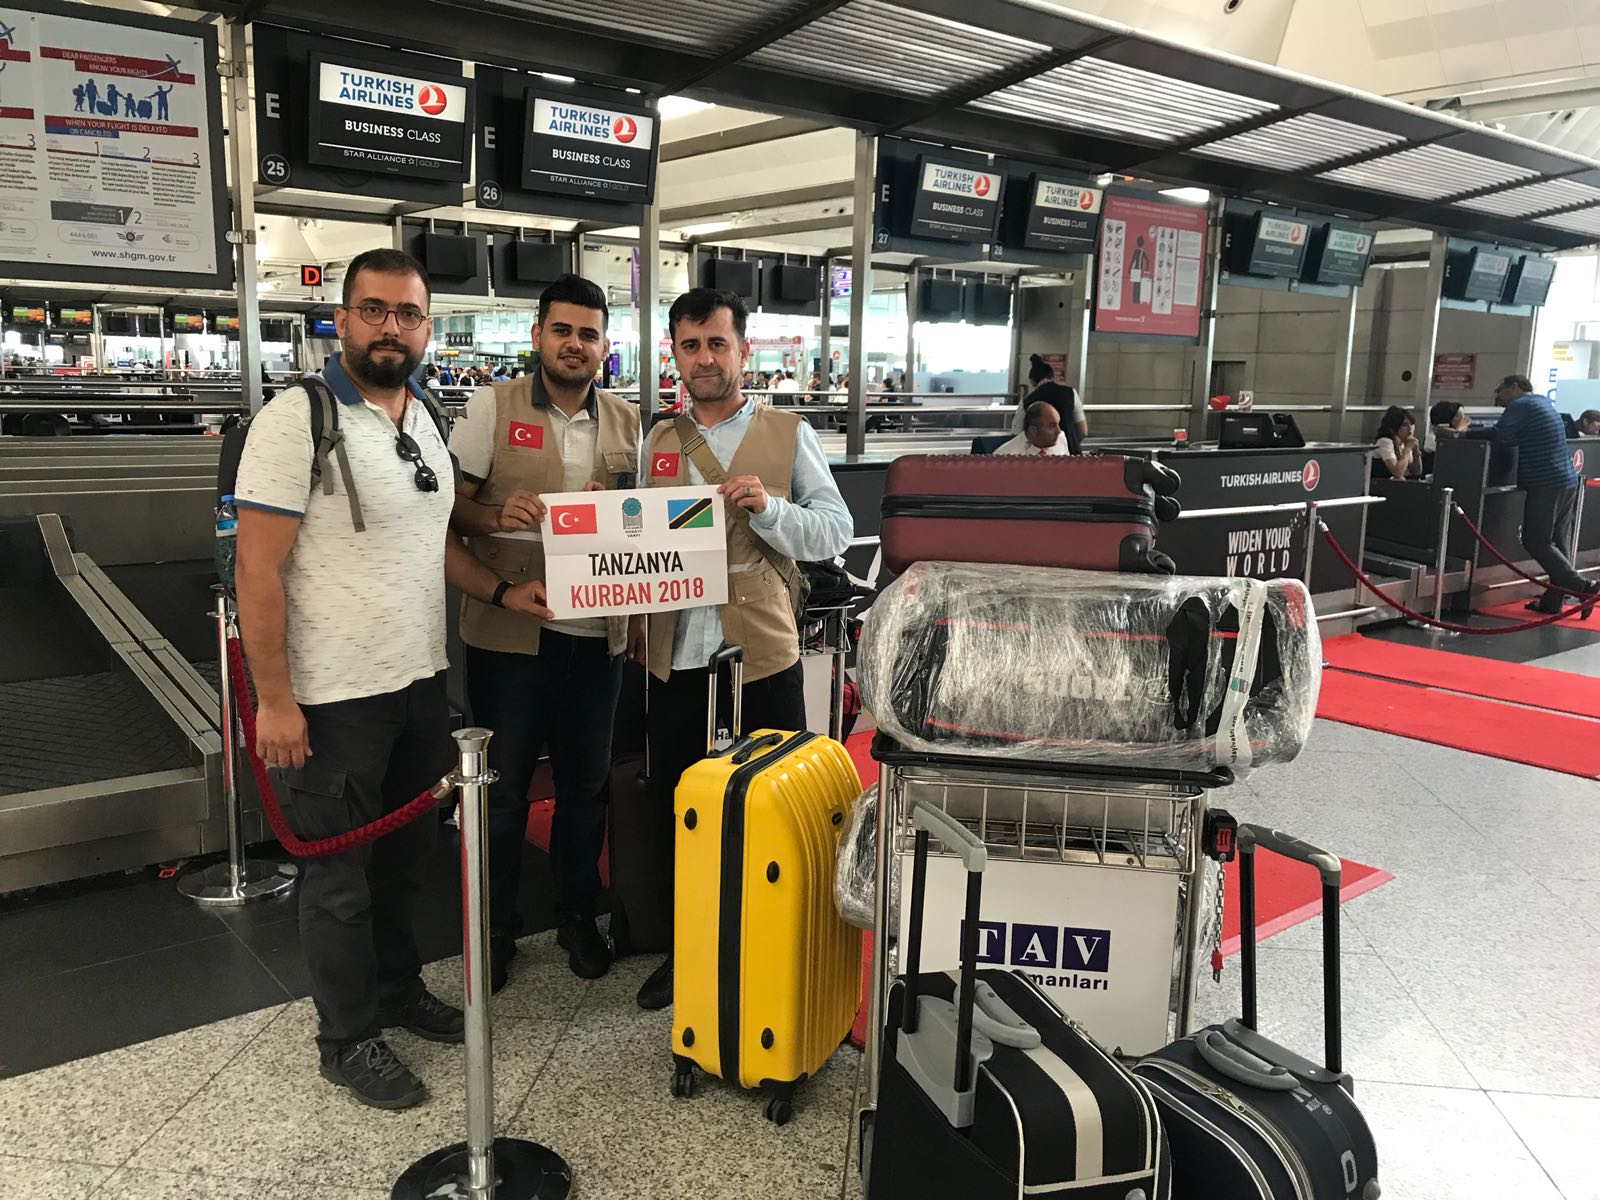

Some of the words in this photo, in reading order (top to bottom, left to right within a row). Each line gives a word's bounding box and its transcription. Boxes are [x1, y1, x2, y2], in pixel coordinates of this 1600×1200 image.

[62, 52, 79, 60] DEAR
[340, 71, 414, 95] TURKISH
[266, 92, 280, 119] E
[339, 87, 414, 109] AIRLINES
[550, 106, 610, 126] TURKISH
[108, 122, 130, 130] FLIGHT
[139, 124, 168, 134] DELAYED
[344, 120, 404, 137] BUSINESS
[407, 130, 441, 143] CLASS
[549, 120, 610, 138] AIRLINES
[27, 134, 35, 147] 3
[484, 126, 496, 148] E
[95, 141, 99, 154] 1
[143, 147, 150, 158] 2
[192, 152, 200, 166] 3
[344, 150, 364, 158] STAR
[366, 152, 406, 164] ALLIANCE
[419, 160, 440, 168] GOLD
[552, 149, 600, 164] BUSINESS
[602, 157, 631, 168] CLASS
[266, 160, 284, 176] 25
[935, 168, 974, 183] TURKISH
[569, 178, 601, 188] ALLIANCE
[932, 179, 973, 193] AIRLINES
[483, 186, 498, 200] 26
[882, 184, 890, 202] E
[1046, 185, 1080, 197] TURKISH
[932, 202, 964, 214] BUSINESS
[965, 206, 984, 216] CLASS
[1044, 195, 1078, 208] AIRLINES
[118, 210, 124, 223] 1
[134, 211, 142, 224] 2
[1043, 216, 1071, 227] BUSINESS
[1072, 219, 1088, 229] CLASS
[878, 234, 888, 245] 27
[1225, 233, 1231, 248] E
[91, 250, 176, 262] www.shgm.gov.tr
[994, 245, 1003, 255] 28
[304, 268, 319, 284] D
[1221, 474, 1262, 488] TURKISH
[1262, 470, 1302, 485] AIRLINES
[1228, 531, 1262, 553] WIDEN
[1265, 526, 1290, 550] YOUR
[588, 551, 683, 577] TANZANYA
[570, 582, 652, 609] KURBAN
[658, 576, 704, 603] 2018
[1028, 972, 1108, 990] manları
